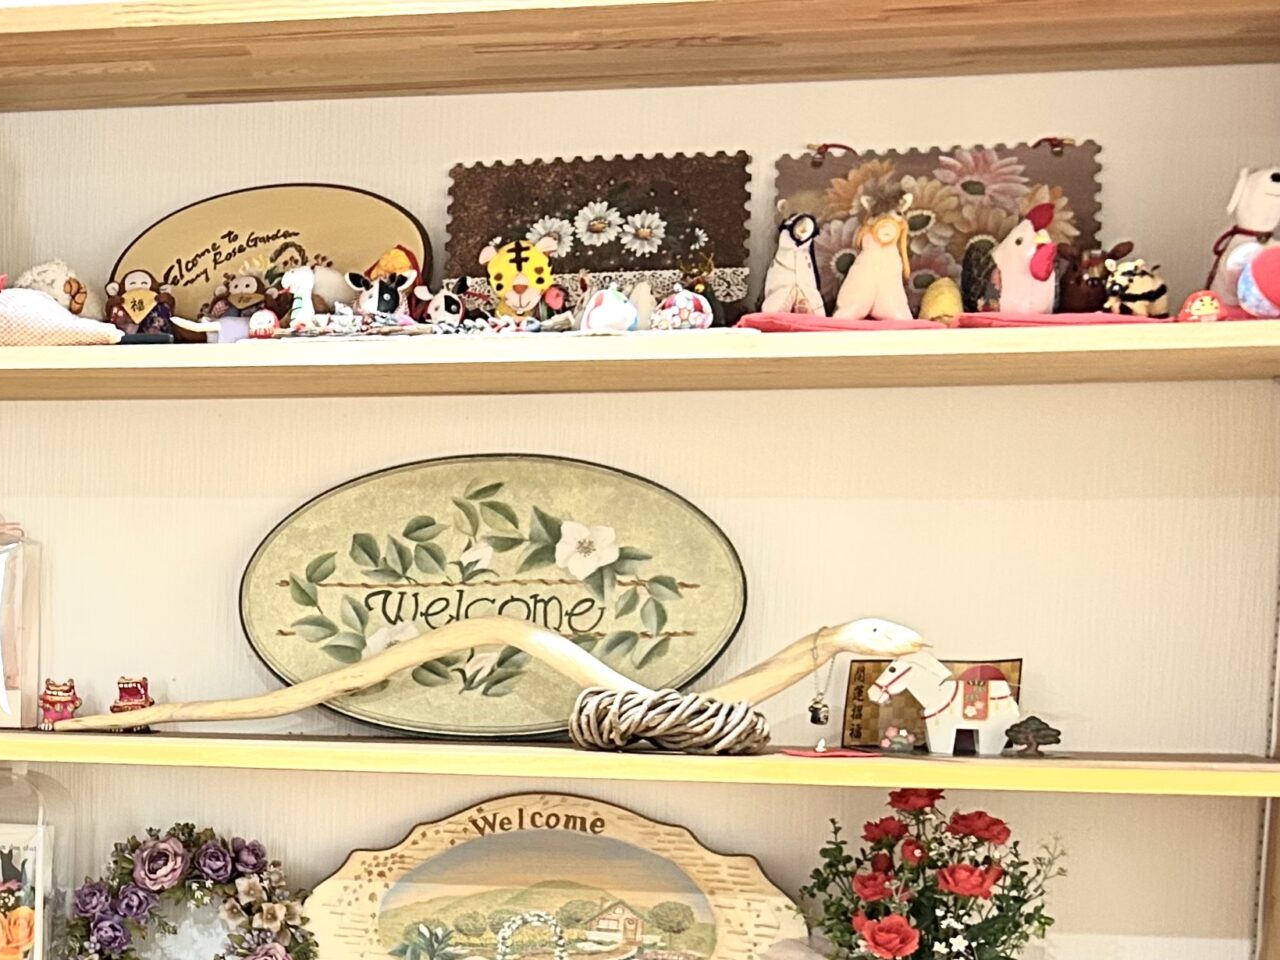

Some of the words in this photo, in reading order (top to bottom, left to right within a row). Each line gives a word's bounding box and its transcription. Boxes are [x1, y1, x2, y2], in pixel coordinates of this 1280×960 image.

[221, 230, 239, 244] to
[212, 243, 247, 270] Rose
[130, 297, 146, 312] 福
[364, 589, 606, 633] Welcome
[468, 807, 606, 837] Welcome
